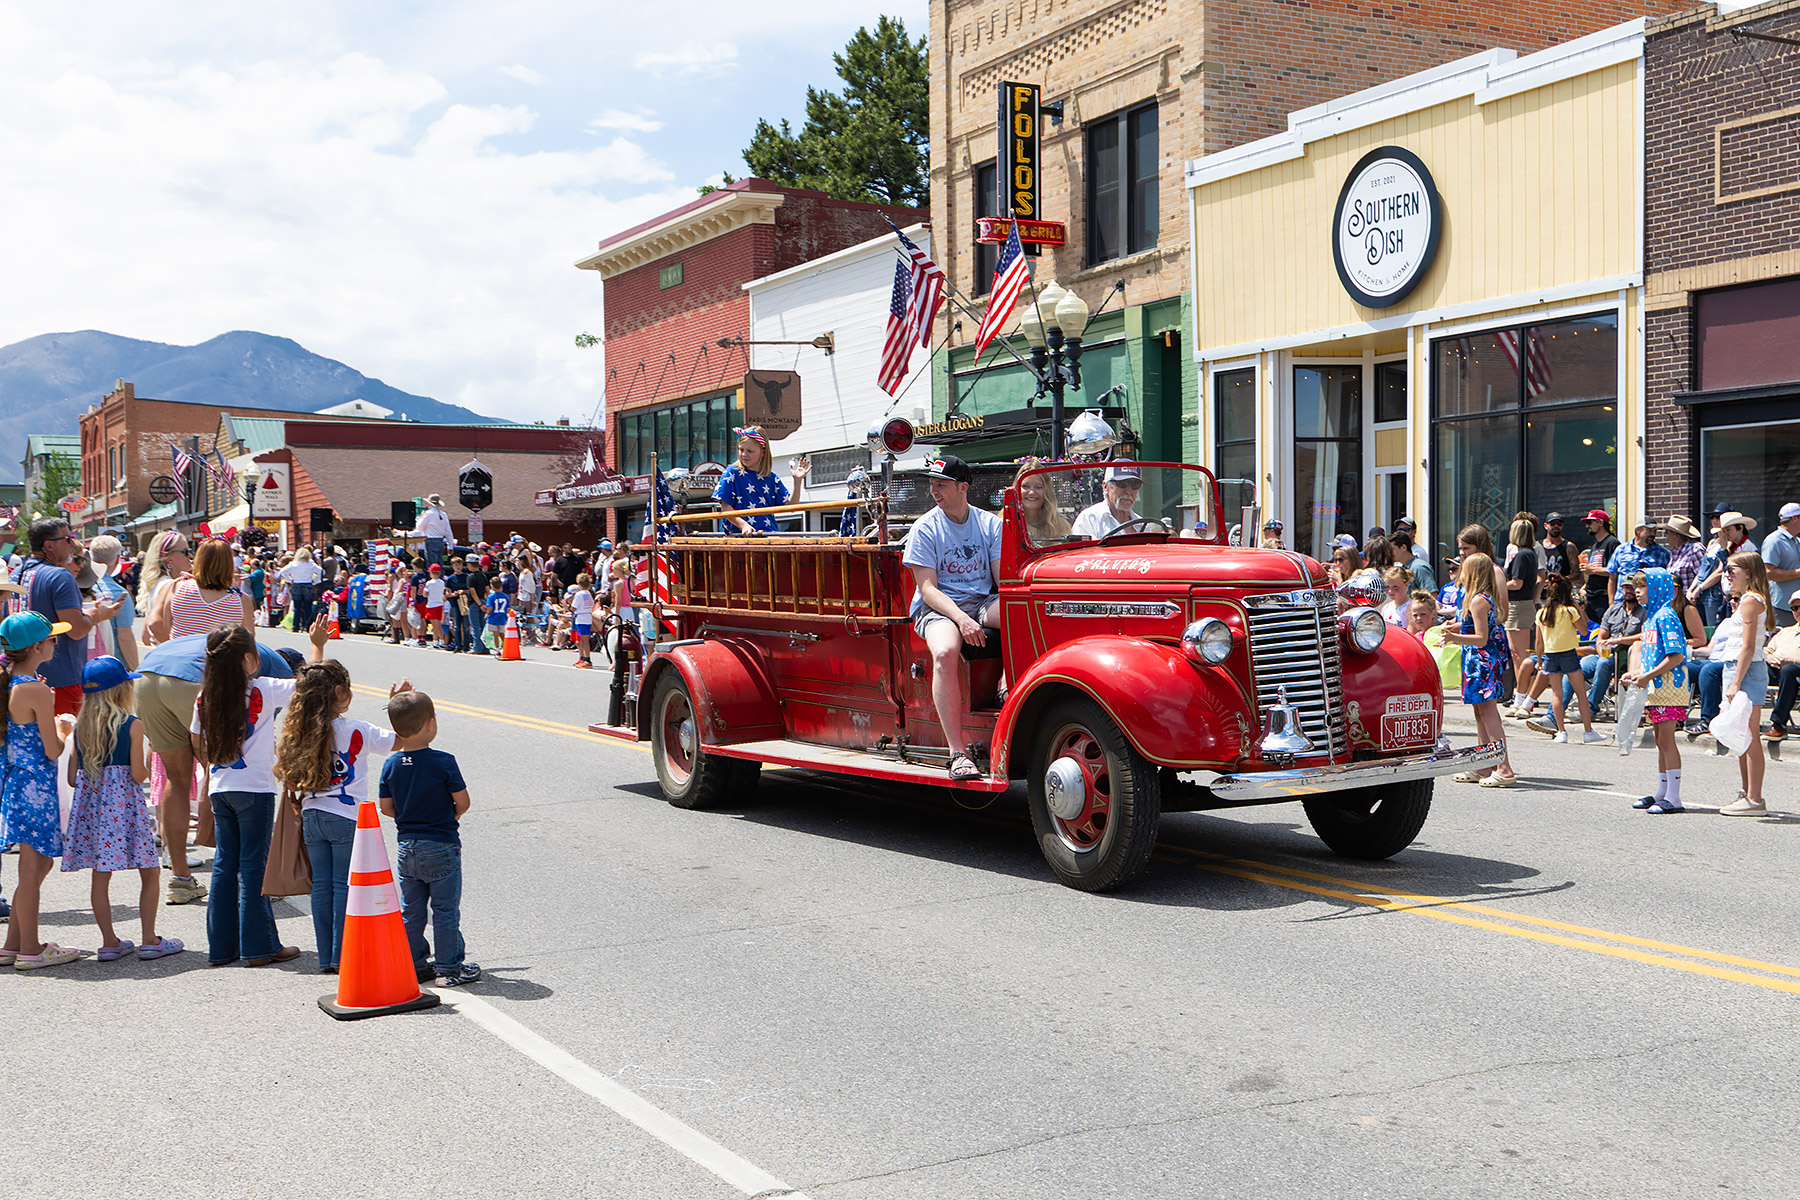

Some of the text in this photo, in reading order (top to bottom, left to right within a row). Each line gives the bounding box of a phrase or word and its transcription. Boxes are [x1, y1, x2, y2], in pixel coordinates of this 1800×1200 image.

[1014, 86, 1034, 216] FOLOS
[1371, 178, 1383, 188] EST.
[1348, 191, 1419, 237] SOUTHERN
[993, 223, 1063, 239] PU & GRILL
[1365, 227, 1404, 266] DISH
[1357, 269, 1384, 286] KITCHEN
[1393, 261, 1411, 281] HOME
[913, 415, 984, 437] OSTER & LOGAN'S
[461, 488, 480, 496] Office
[1310, 505, 1341, 515] OPEN
[493, 598, 507, 613] 17
[1134, 605, 1163, 615] TRUCK
[1388, 699, 1430, 713] FIRE DEPT.
[1394, 718, 1429, 738] DDF835
